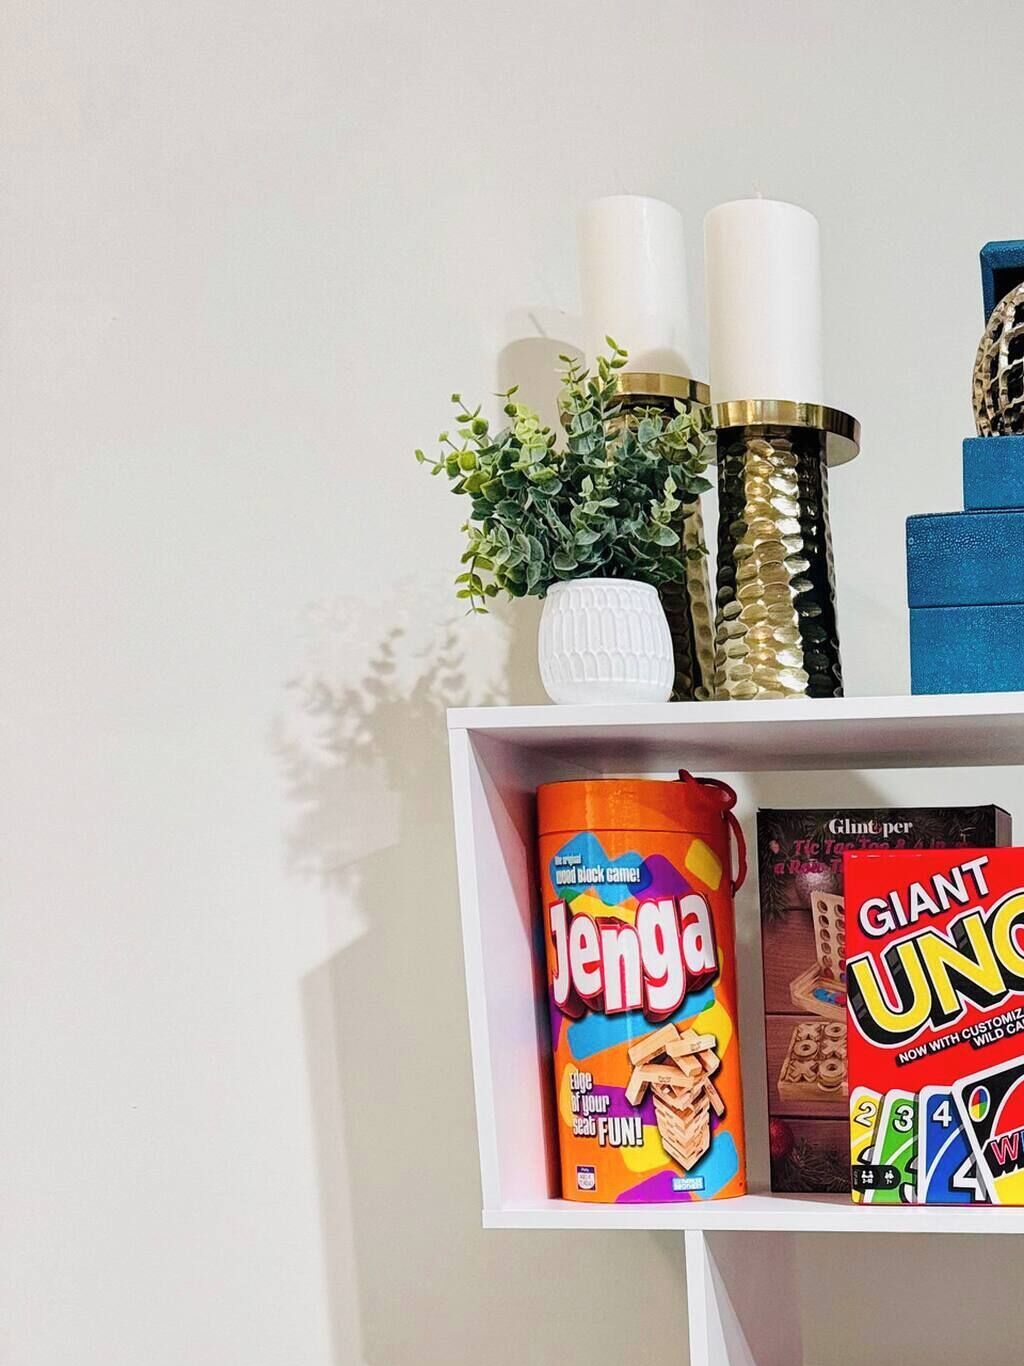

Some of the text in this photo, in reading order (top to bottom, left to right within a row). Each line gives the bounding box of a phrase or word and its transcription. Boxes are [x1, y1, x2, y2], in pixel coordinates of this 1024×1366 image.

[857, 855, 991, 938] GIANT
[548, 892, 719, 1017] Jenga
[898, 1043, 928, 1064] NOW
[929, 1032, 961, 1052] WITH
[972, 1029, 1005, 1047] WILD
[581, 1095, 610, 1117] your
[854, 1101, 877, 1128] 2
[893, 1104, 914, 1132] 3
[932, 1100, 952, 1128] 4
[573, 1115, 643, 1146] seat FUN!
